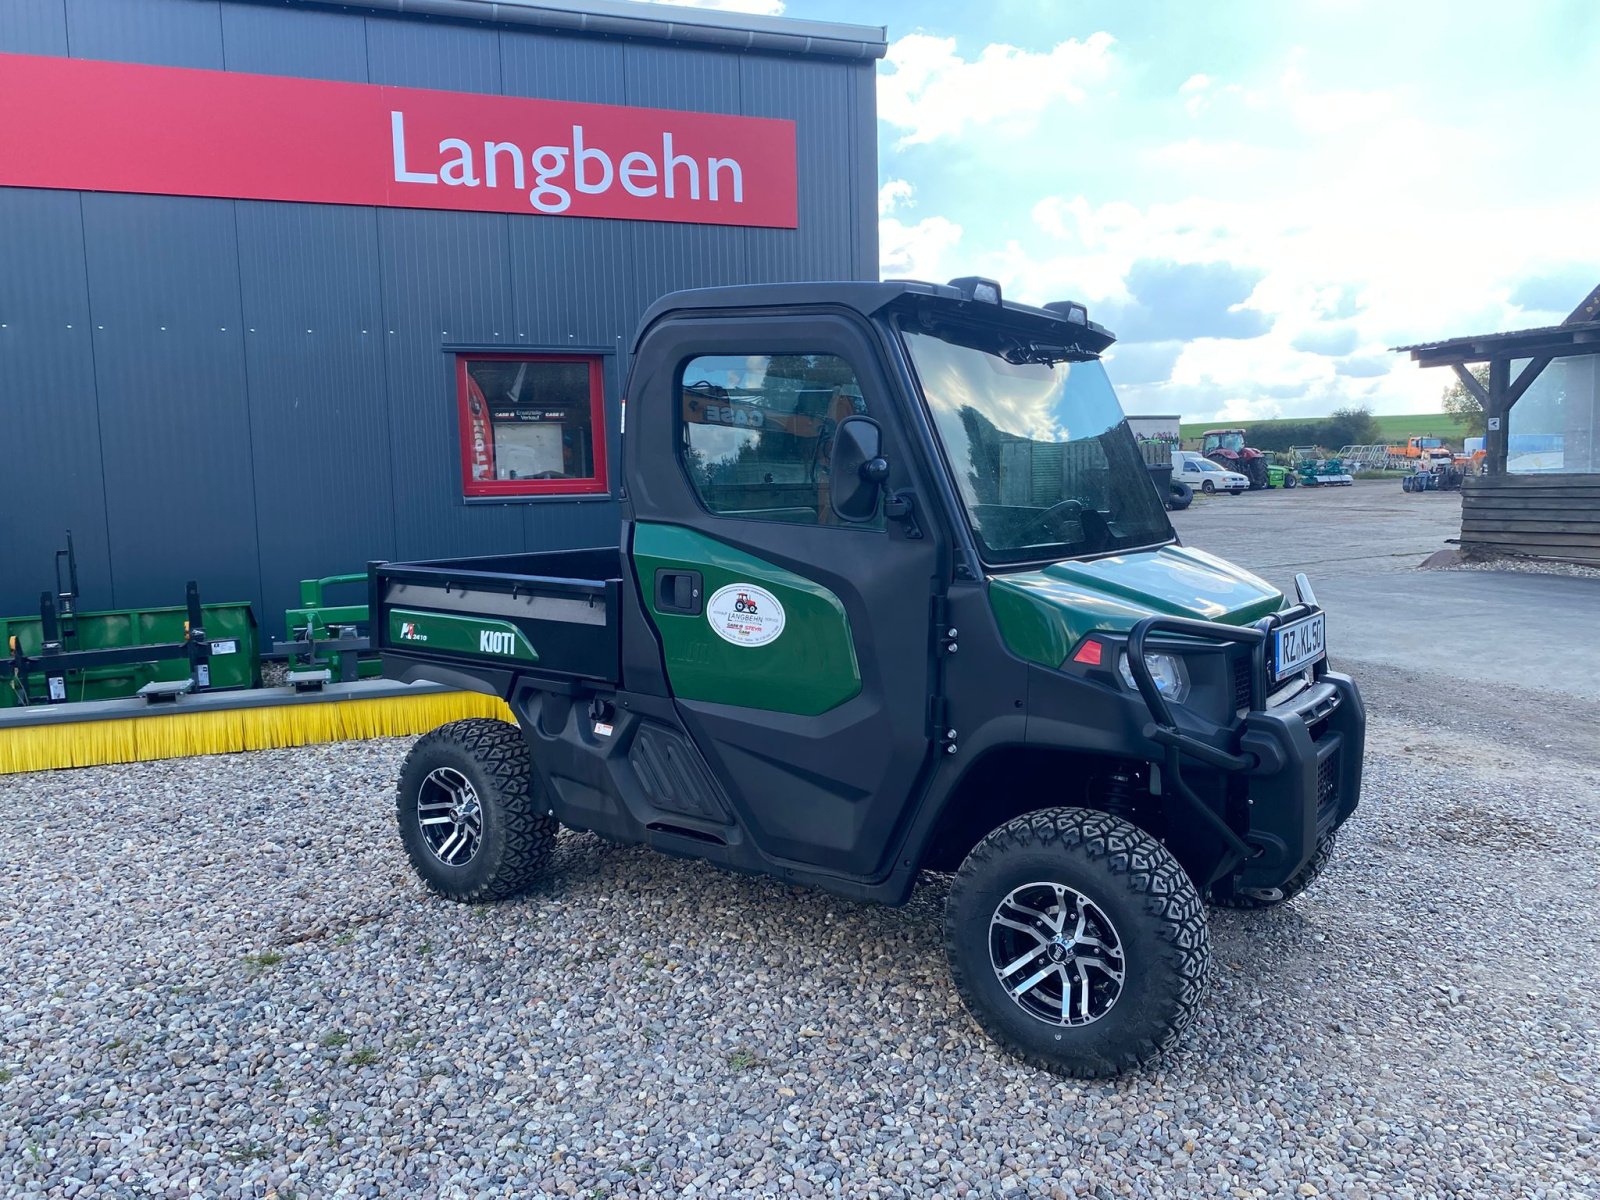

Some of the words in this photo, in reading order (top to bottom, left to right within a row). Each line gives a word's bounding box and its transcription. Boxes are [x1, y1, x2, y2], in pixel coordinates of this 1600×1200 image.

[391, 111, 743, 213] Langbehn
[727, 613, 763, 623] LANGBEHN
[480, 630, 515, 655] KIOTI
[1283, 630, 1296, 664] RZ
[1301, 625, 1312, 656] KL
